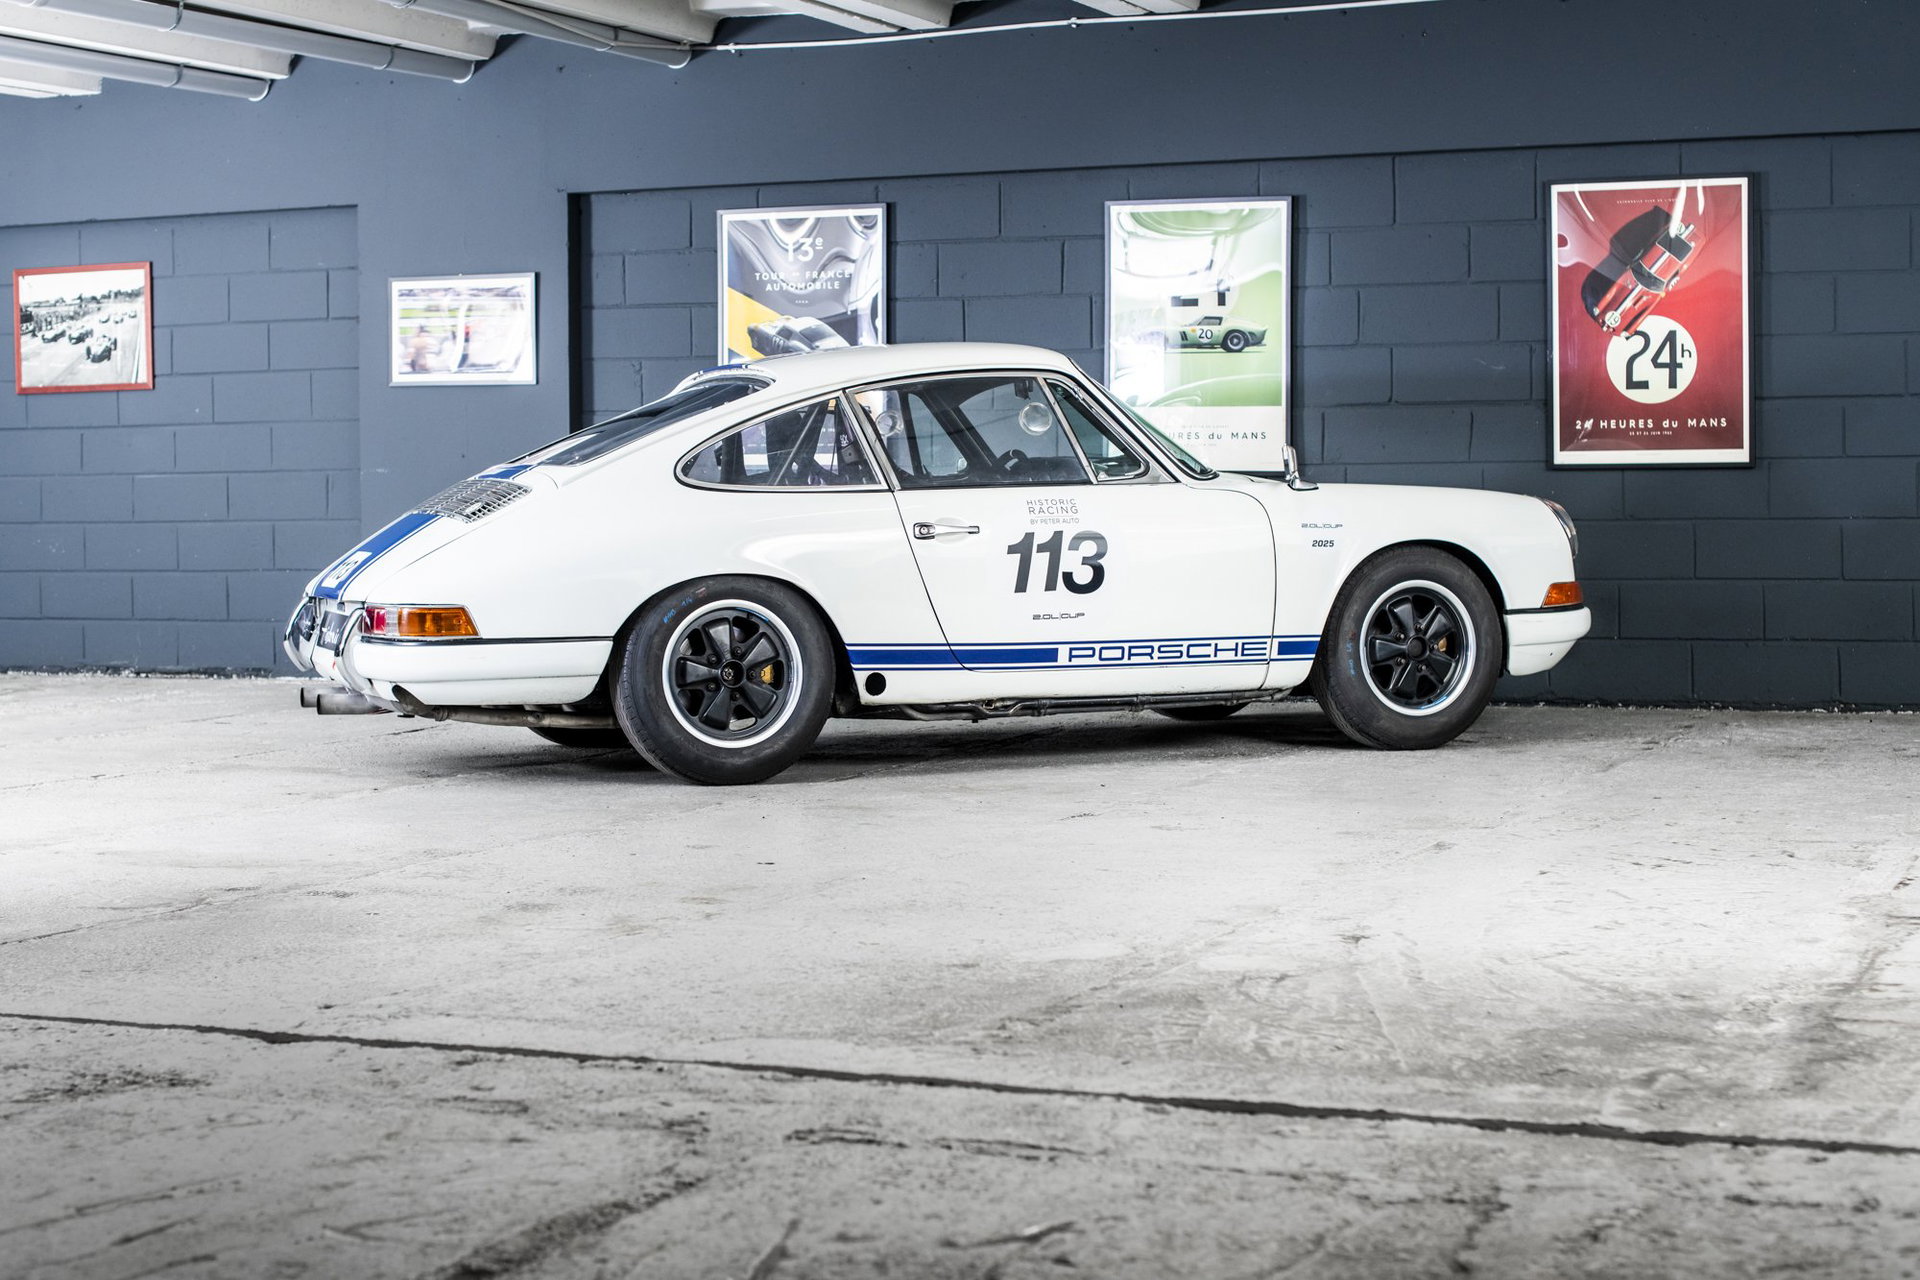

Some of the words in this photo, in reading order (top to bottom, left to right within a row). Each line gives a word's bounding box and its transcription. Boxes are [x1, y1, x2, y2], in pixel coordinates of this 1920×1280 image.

[755, 271, 785, 281] TOUR
[805, 270, 850, 279] FRANCE
[766, 281, 840, 291] AUTOMOBILE
[1198, 329, 1213, 340] 20
[1626, 329, 1692, 390] 24h
[1600, 418, 1653, 429] HEURES
[1662, 418, 1678, 428] du
[1687, 417, 1727, 428] MANS
[1208, 432, 1222, 440] du
[1231, 432, 1267, 440] MANS
[1026, 498, 1077, 506] HISTORIC
[1028, 506, 1079, 515] RACING
[1312, 539, 1335, 547] 2025
[1007, 530, 1109, 595] 113
[1068, 641, 1268, 662] PORSCHE
